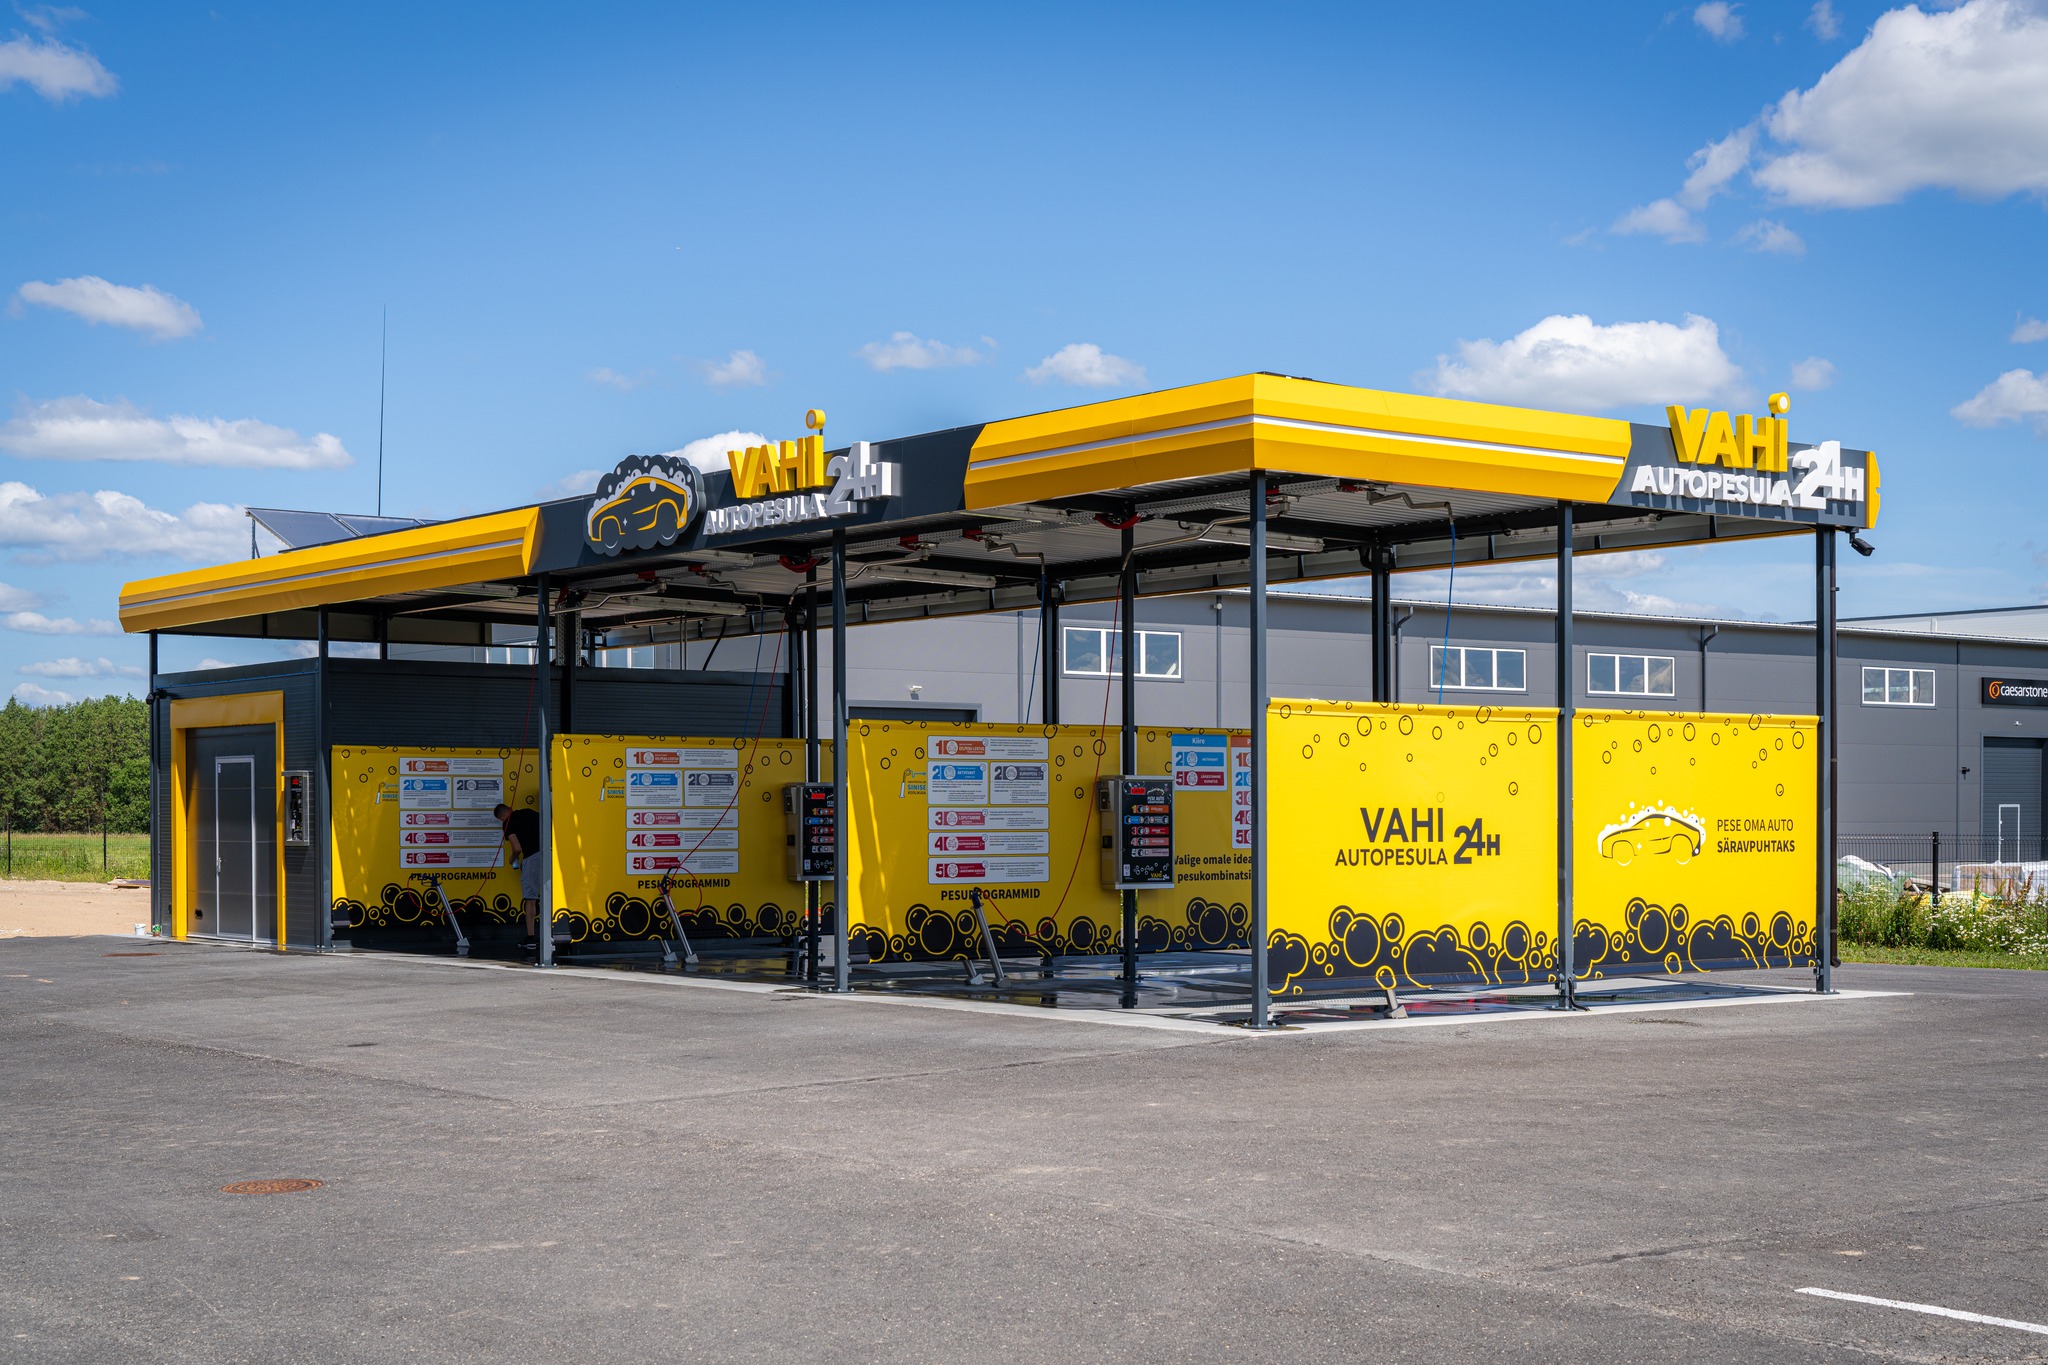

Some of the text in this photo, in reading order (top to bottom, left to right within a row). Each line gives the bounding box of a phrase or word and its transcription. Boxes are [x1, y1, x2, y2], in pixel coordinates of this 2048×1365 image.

[1631, 464, 1794, 507] AUTOPESULA
[703, 493, 827, 536] AUTOPESULA
[2000, 685, 2048, 697] caesarstone
[935, 740, 943, 755] 1
[1192, 737, 1206, 745] Kiire
[633, 752, 640, 764] 1
[1175, 752, 1183, 766] 2
[1236, 752, 1243, 767] 1
[630, 773, 638, 785] 2
[688, 773, 696, 785] 2
[932, 765, 941, 780] 2
[994, 765, 1002, 780] 2
[1175, 771, 1183, 786] 5
[1235, 772, 1243, 786] 2
[403, 780, 411, 790] 2
[456, 780, 464, 790] 2
[1235, 791, 1243, 805] 3
[405, 813, 413, 825] 3
[633, 812, 640, 825] 3
[934, 811, 943, 825] 3
[1234, 810, 1243, 825] 4
[1360, 807, 1444, 843] VAHI
[1717, 819, 1794, 832] PESE OMA AUTO
[405, 833, 413, 843] 4
[632, 834, 640, 846] 4
[934, 836, 943, 851] 4
[1235, 829, 1243, 844] 5
[1717, 836, 1796, 853] SÄRAVPUHTAKS
[405, 853, 413, 864] 5
[632, 857, 640, 870] 5
[1203, 854, 1231, 864] omale
[1335, 848, 1448, 867] AUTOPESULA
[935, 863, 943, 878] 5
[1178, 869, 1251, 883] pesukombinatsi
